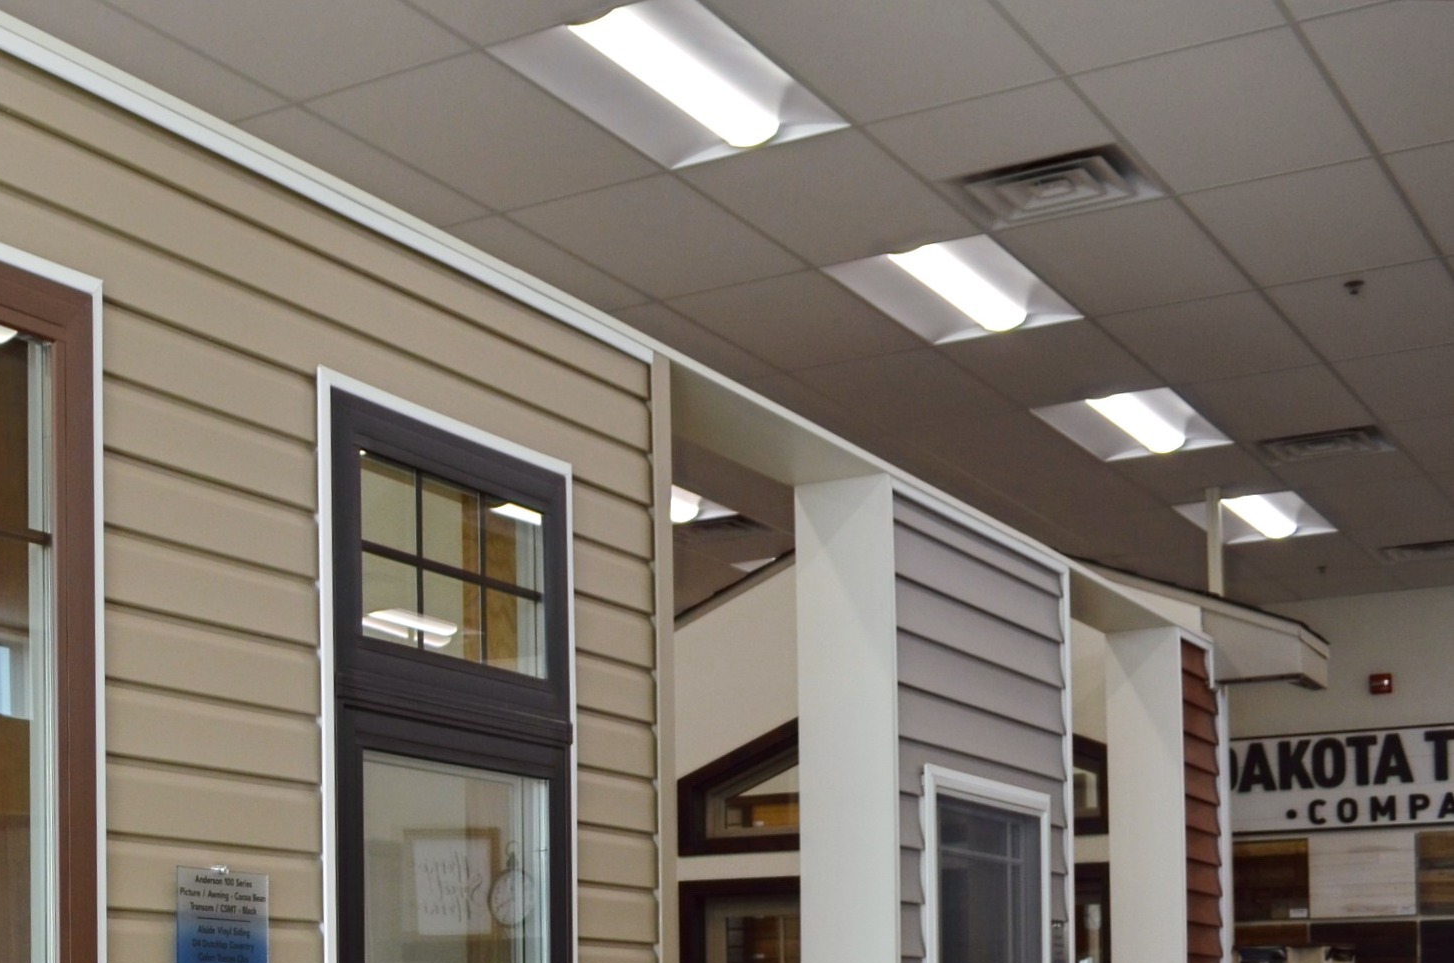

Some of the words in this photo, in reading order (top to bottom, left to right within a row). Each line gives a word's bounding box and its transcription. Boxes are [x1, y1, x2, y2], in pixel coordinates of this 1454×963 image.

[1230, 733, 1414, 793] AKOTA
[194, 874, 223, 885] Anderson
[235, 878, 253, 888] Series
[179, 886, 201, 897] Picture
[207, 889, 230, 902] Awning
[252, 893, 266, 903] Bean
[189, 901, 214, 912] Transom
[242, 906, 257, 916] Black
[217, 926, 232, 937] Vinyl
[233, 927, 251, 939] Siding
